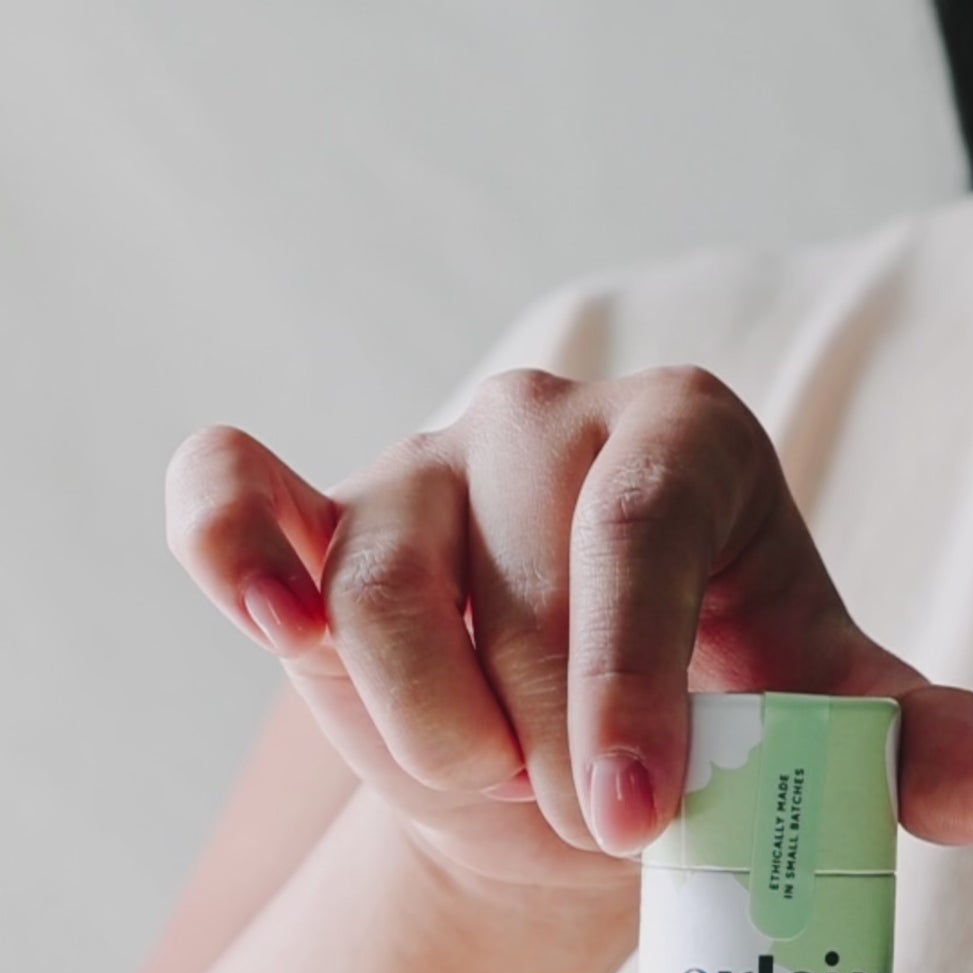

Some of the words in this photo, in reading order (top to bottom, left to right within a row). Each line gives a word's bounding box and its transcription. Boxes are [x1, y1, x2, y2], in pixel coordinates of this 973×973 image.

[790, 768, 804, 830] BATCHES
[769, 817, 784, 890] ETHICALLY
[777, 774, 789, 811] MADE
[785, 836, 798, 879] SMALL
[784, 884, 794, 899] IN
